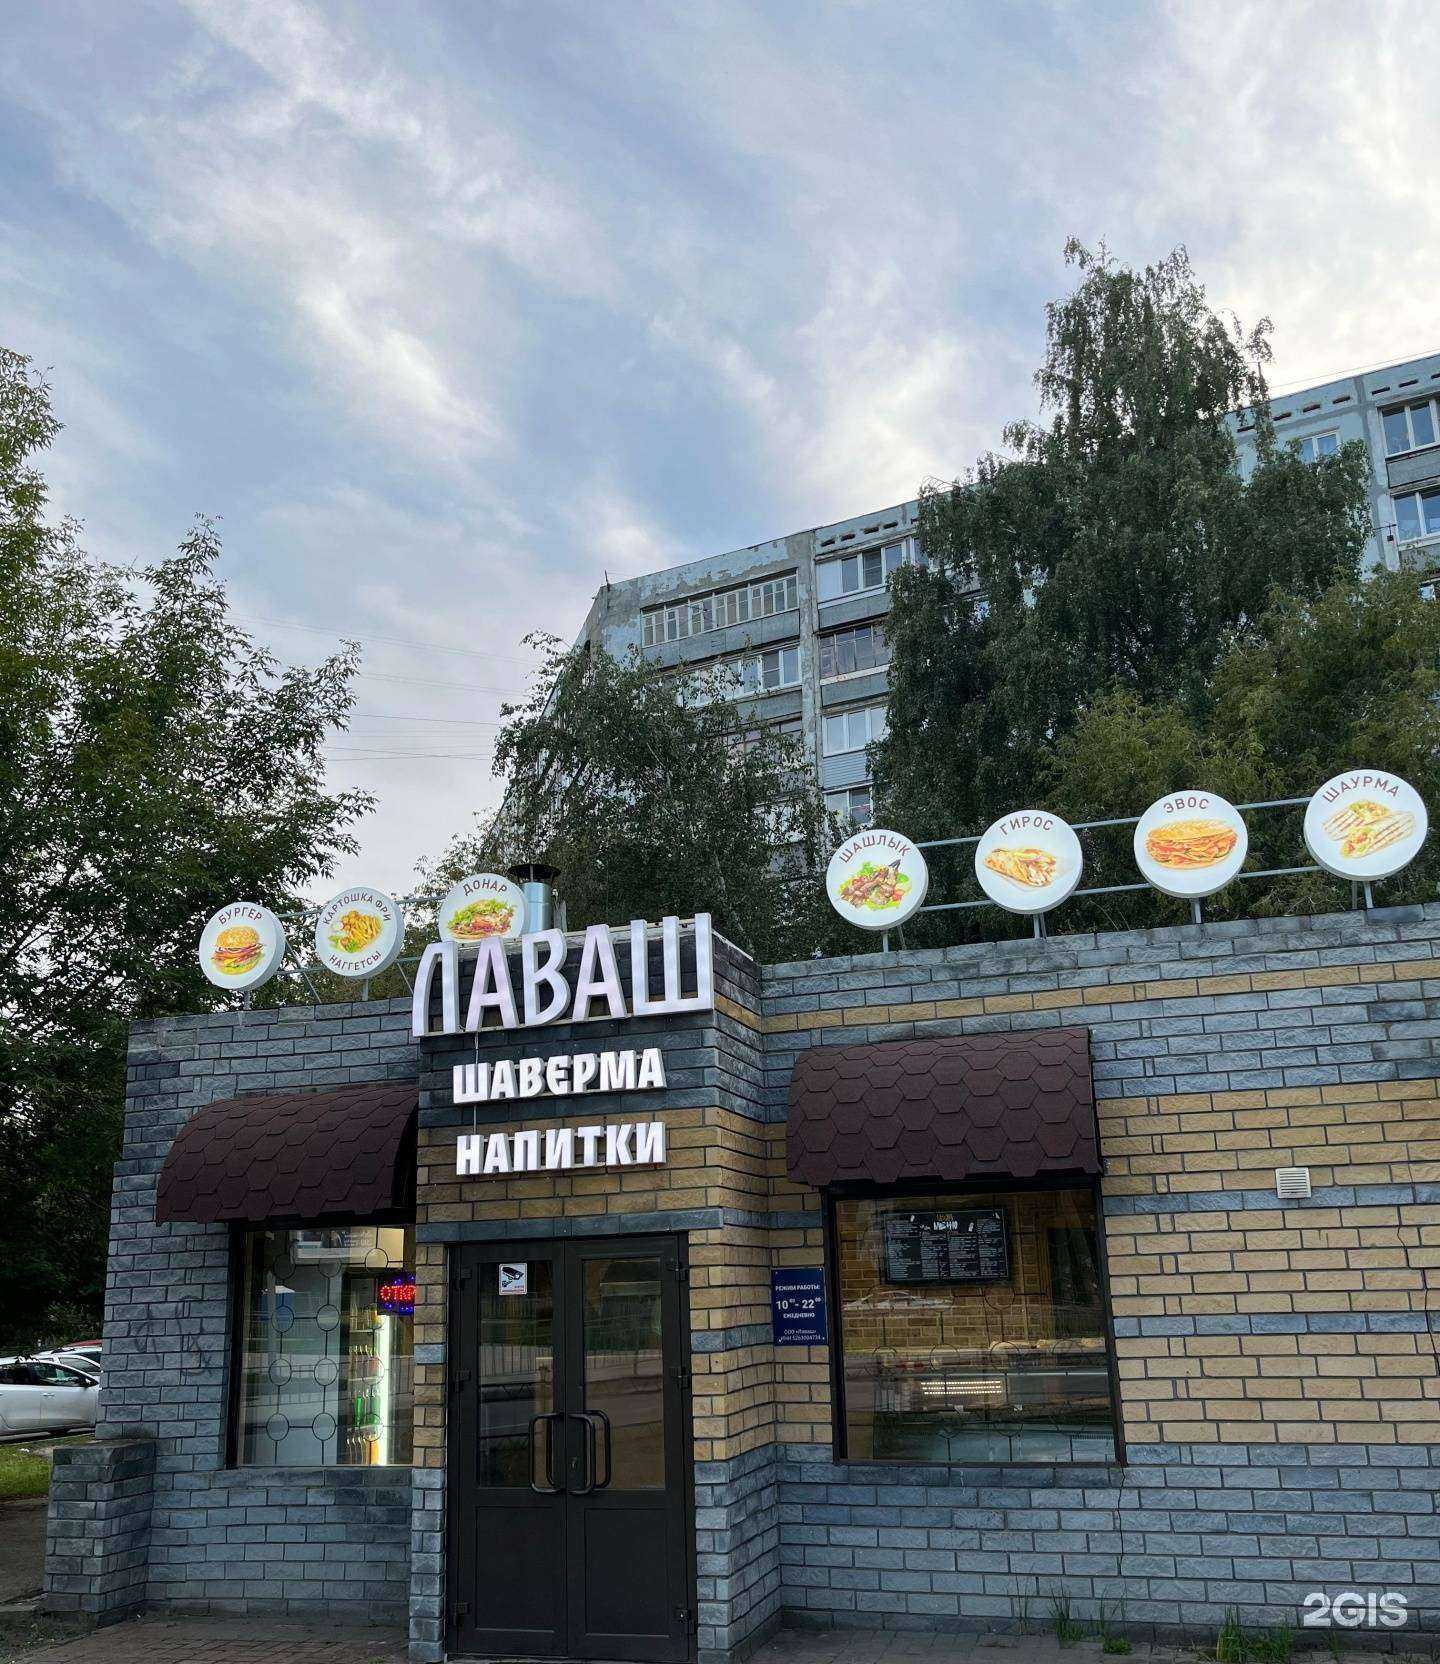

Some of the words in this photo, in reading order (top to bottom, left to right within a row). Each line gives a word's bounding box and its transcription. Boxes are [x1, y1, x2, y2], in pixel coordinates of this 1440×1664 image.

[1322, 776, 1400, 803] ШАУРМА
[1163, 797, 1211, 813] ЭВОС
[1000, 816, 1054, 835] ГИРОС
[839, 835, 910, 864] ШАШЛЫК
[463, 880, 508, 896] ДОНАР
[218, 910, 263, 925] БУРГЕР
[323, 892, 373, 925] КАРТОШКА
[374, 899, 392, 921] ФРИ
[329, 951, 383, 971] НАГГЕТСЫ
[412, 912, 715, 1038] ЛАВАШ
[453, 1048, 667, 1104] ШАВЕРМА
[456, 1121, 667, 1176] НАПИТКИ
